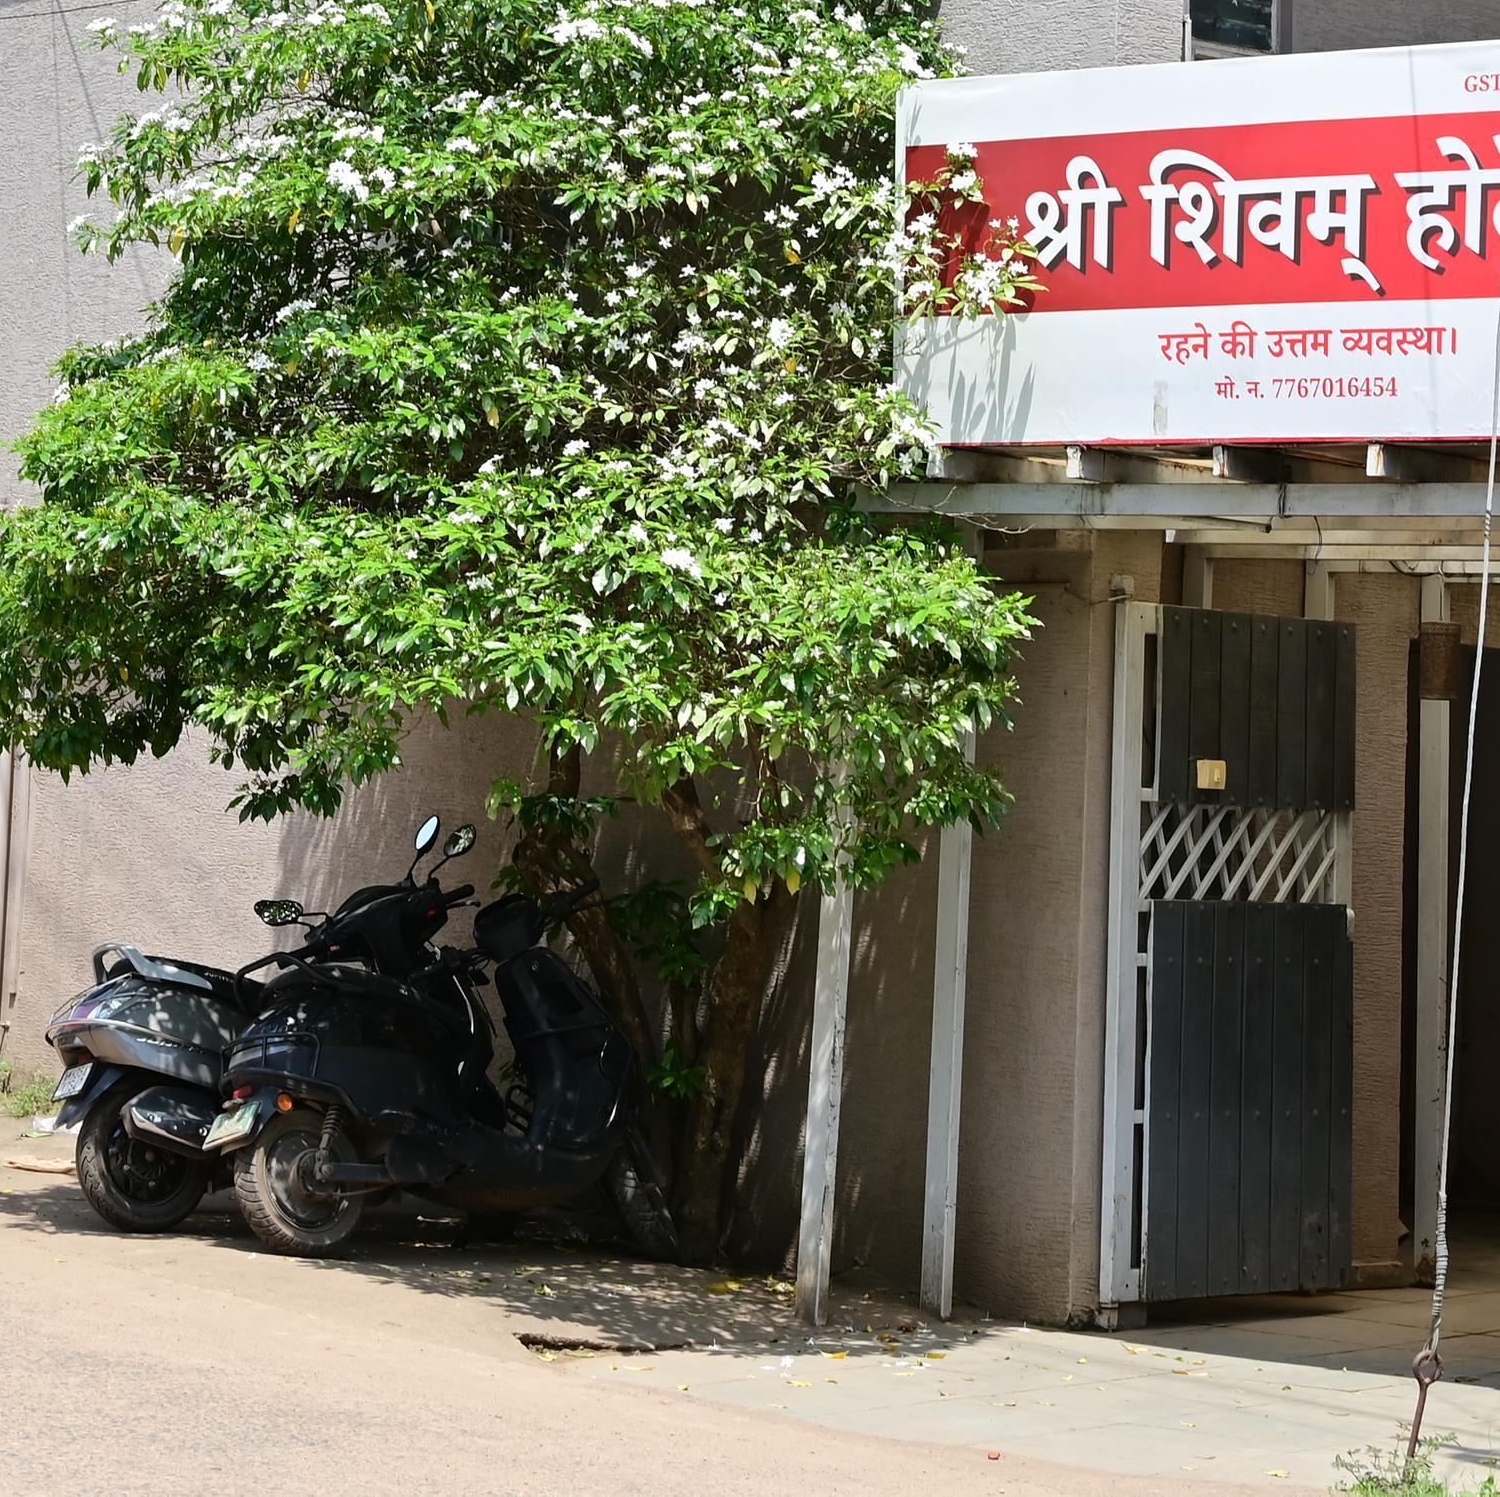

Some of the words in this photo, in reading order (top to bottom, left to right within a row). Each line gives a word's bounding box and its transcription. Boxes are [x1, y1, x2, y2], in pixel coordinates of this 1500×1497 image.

[1024, 155, 1127, 273] श्री
[1139, 148, 1386, 296] शिवम्
[1157, 322, 1212, 365] रहने
[1218, 320, 1258, 359] की
[1264, 329, 1333, 358] उत्तम
[1214, 375, 1240, 400] मो.
[1245, 381, 1265, 399] न.
[1271, 376, 1398, 399] 7767016454
